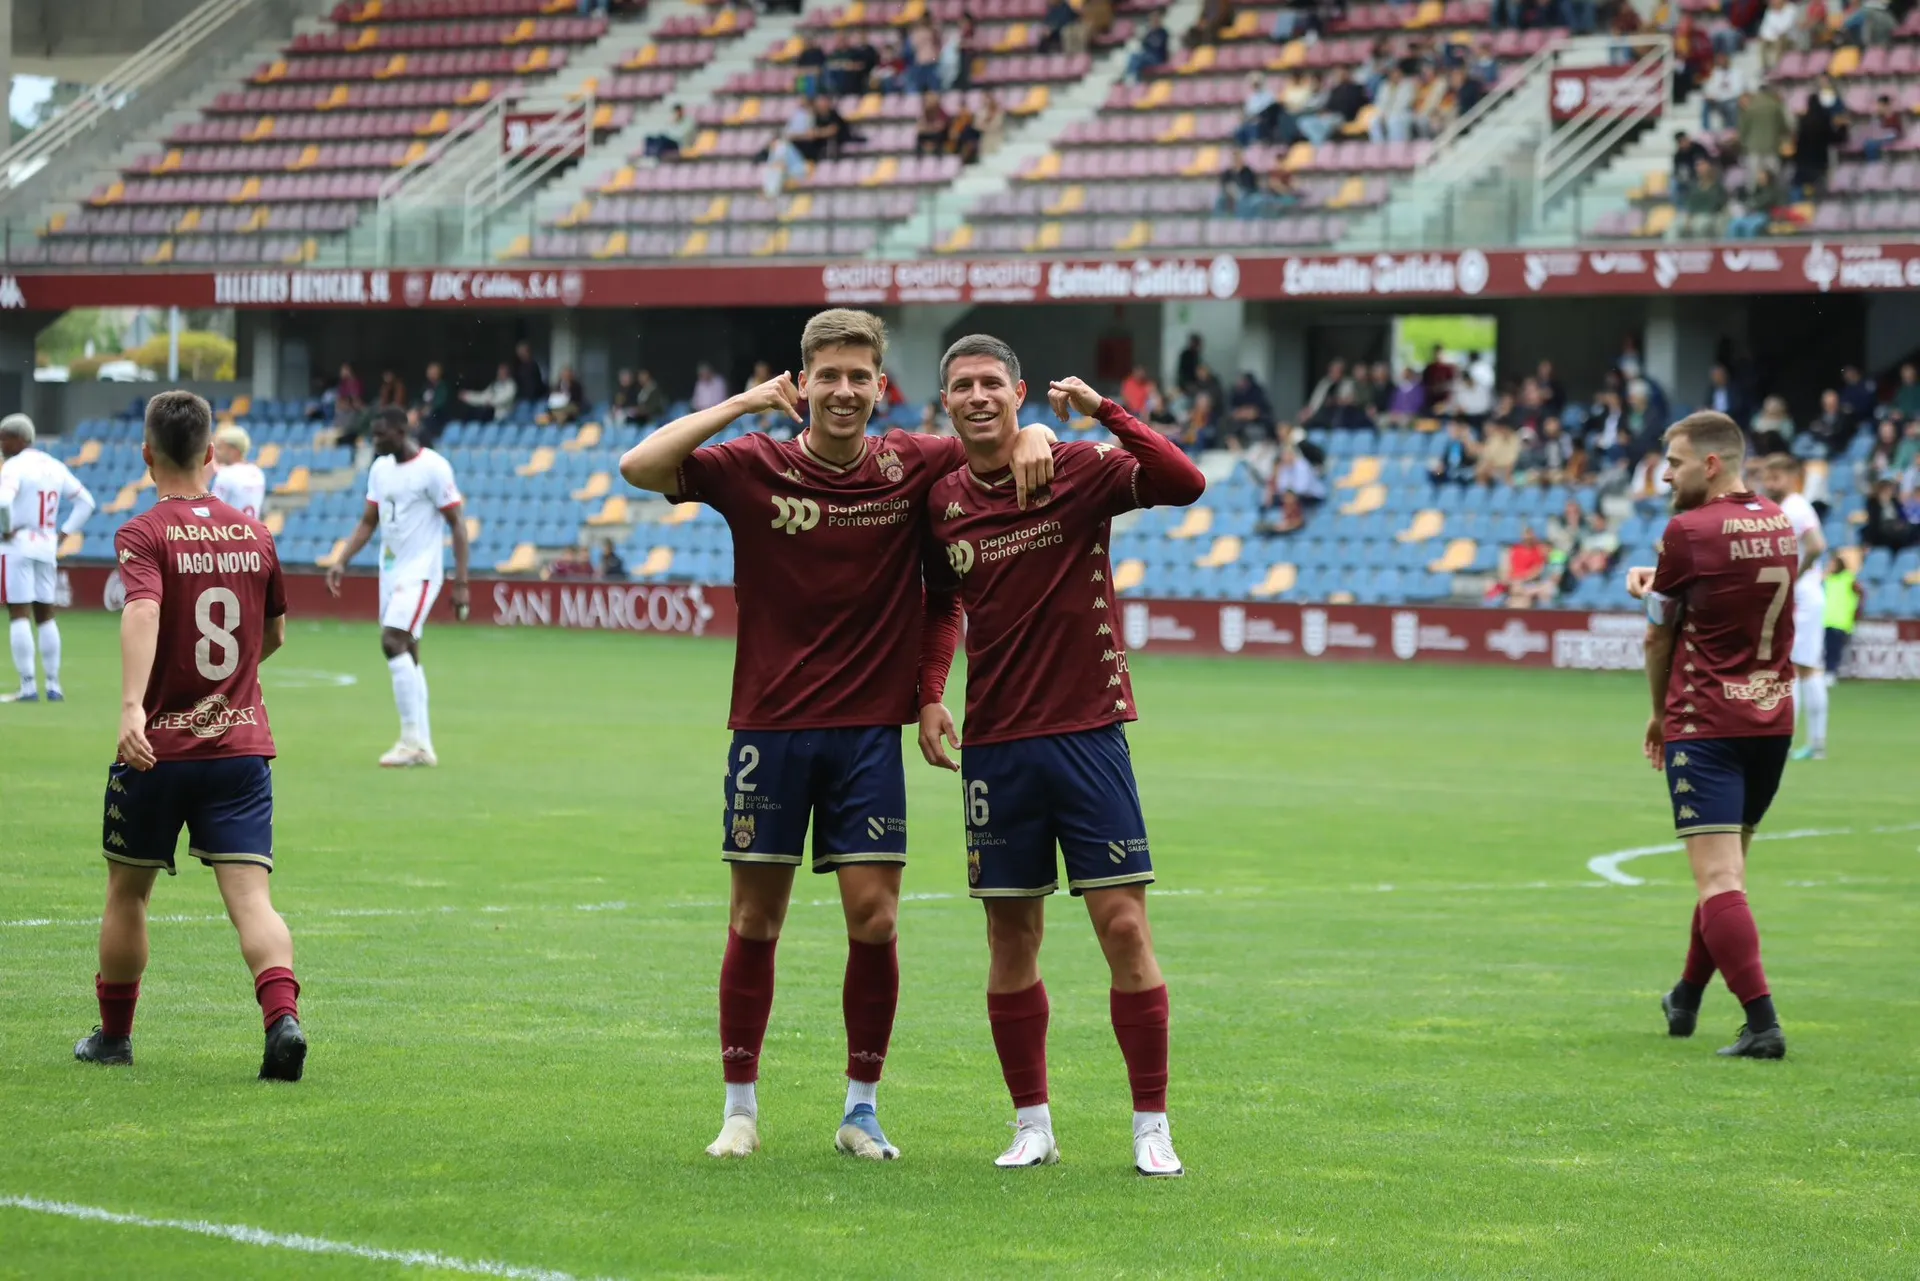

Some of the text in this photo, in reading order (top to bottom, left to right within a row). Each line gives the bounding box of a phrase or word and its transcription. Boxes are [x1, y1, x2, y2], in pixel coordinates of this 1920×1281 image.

[828, 497, 910, 515] Deputación
[828, 512, 909, 527] Pontevedra
[979, 520, 1062, 551] Deputación
[980, 534, 1063, 563] Pontevedra
[1730, 538, 1774, 560] ALEX
[177, 551, 261, 574] IAGO NOVO
[493, 582, 691, 632] SAN MARCOS
[1756, 566, 1791, 661] 7
[195, 587, 240, 681] 8
[736, 744, 760, 792] 2
